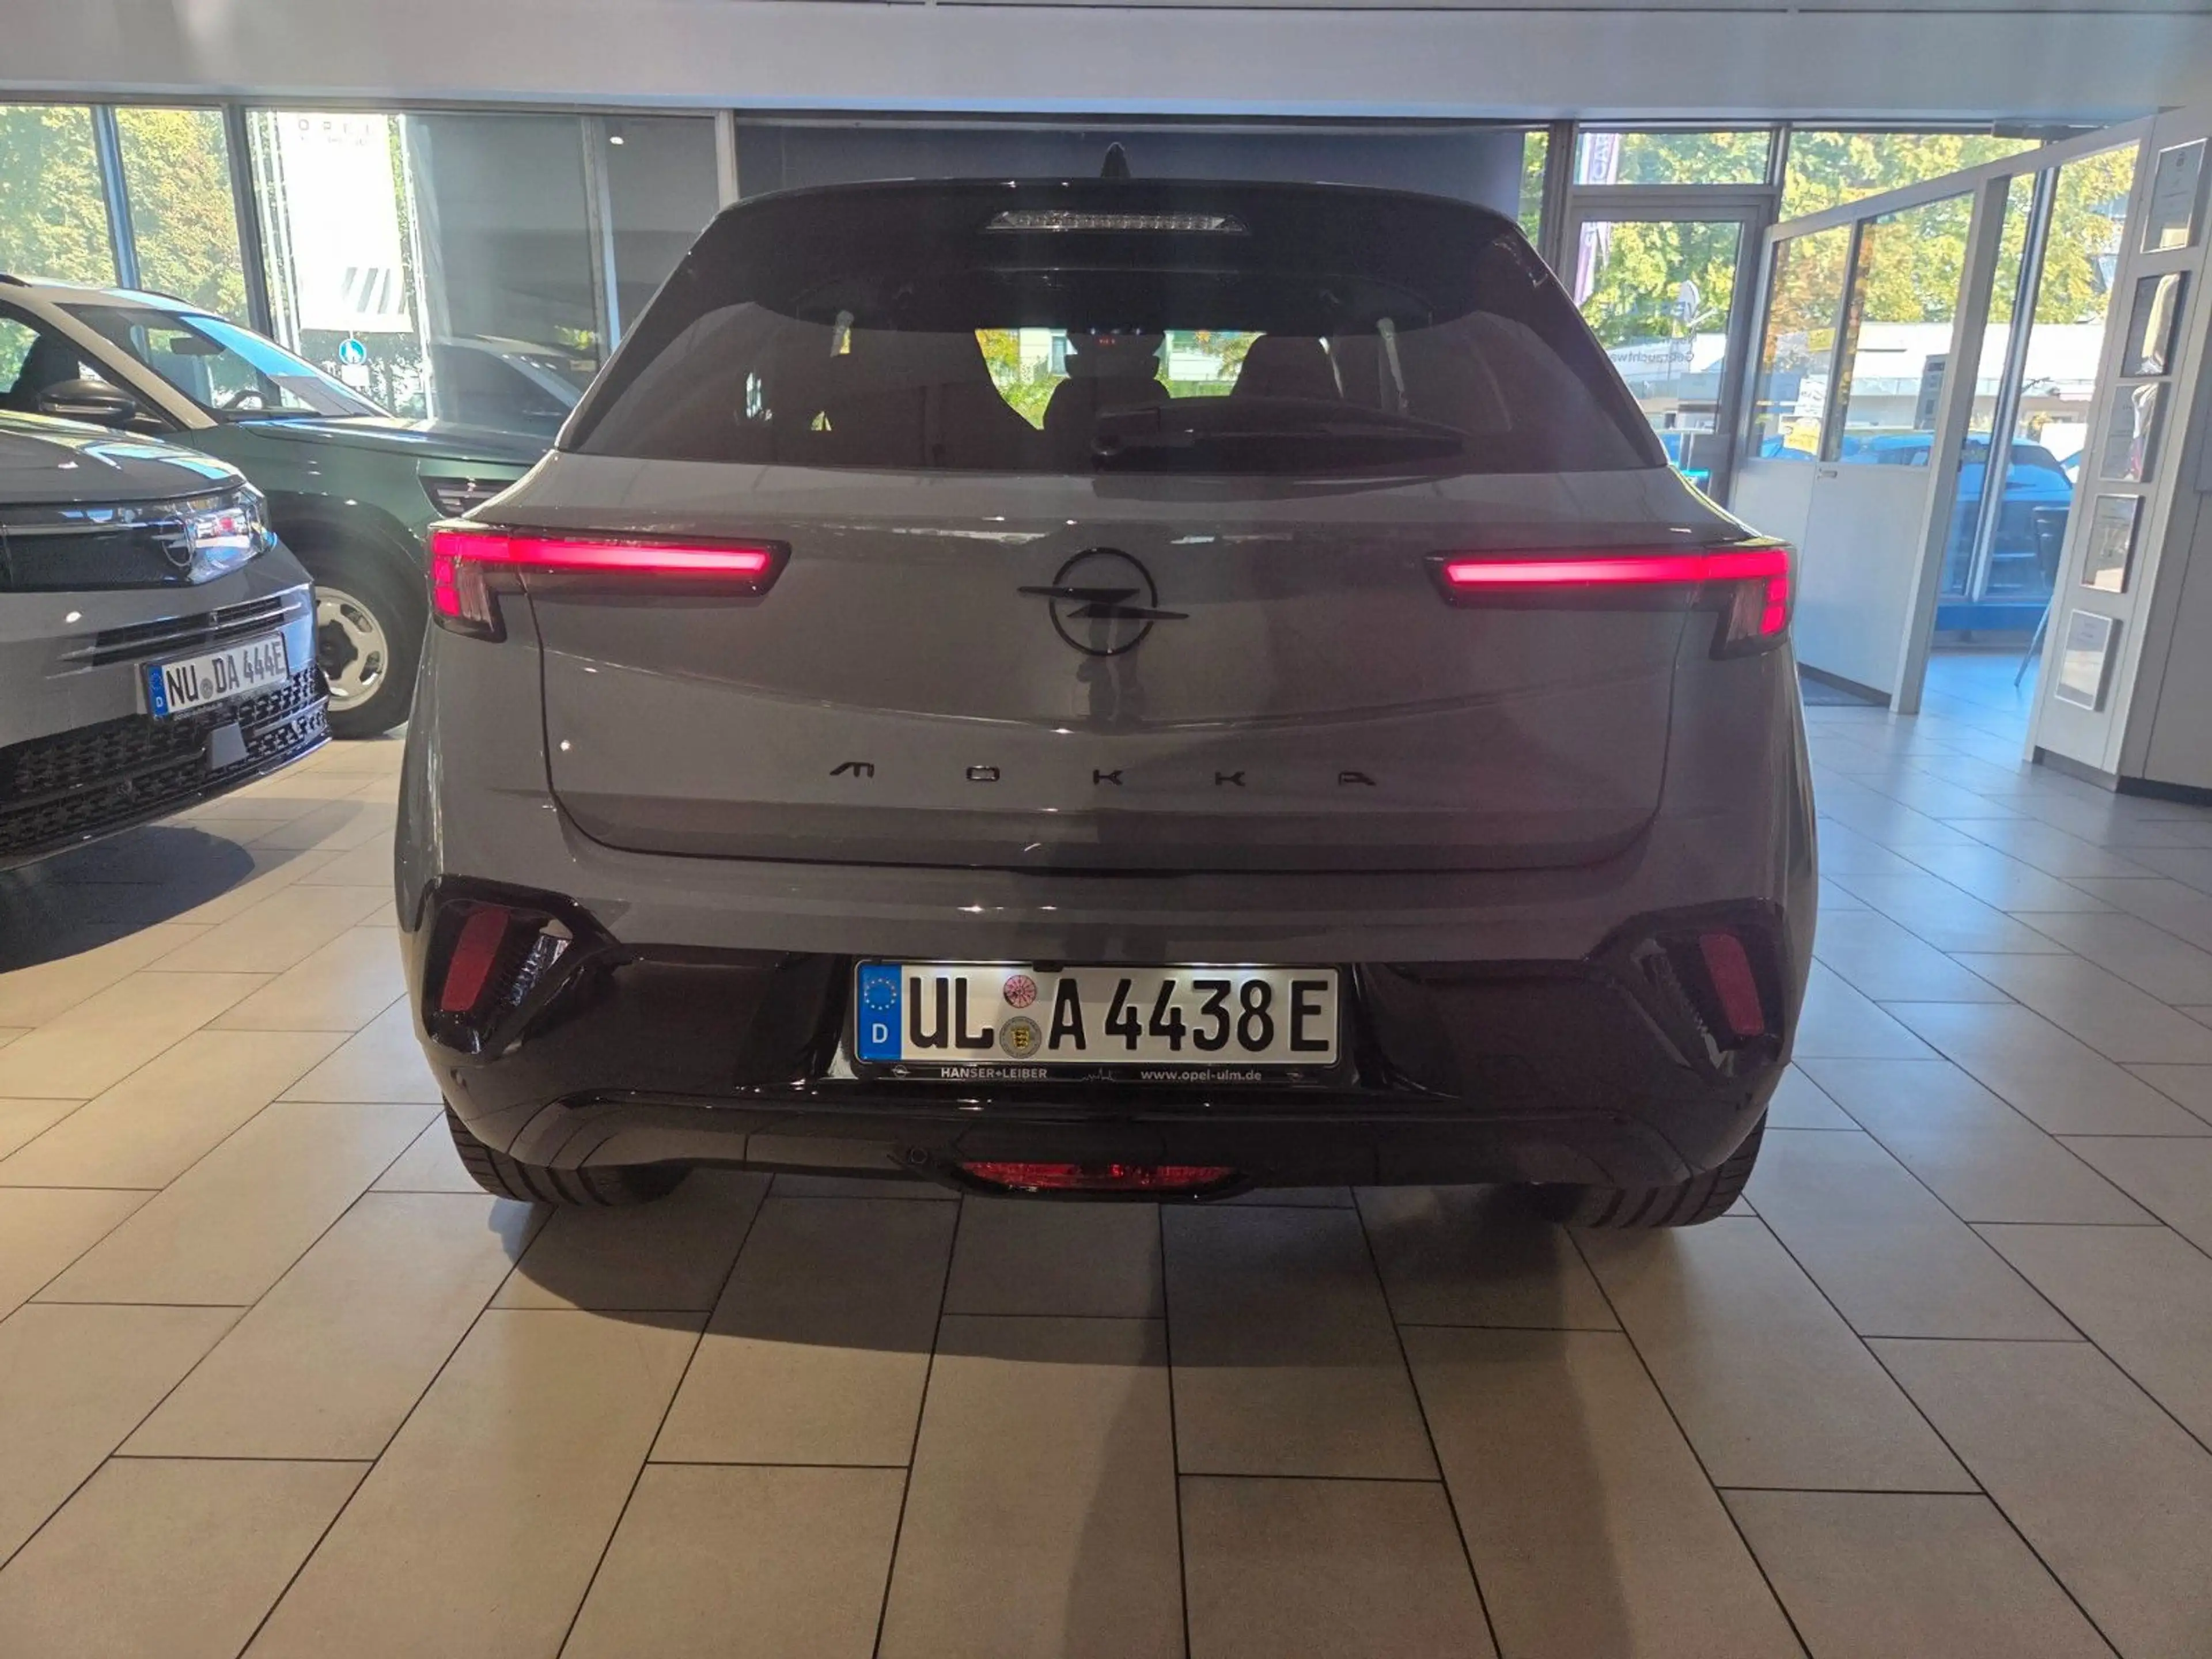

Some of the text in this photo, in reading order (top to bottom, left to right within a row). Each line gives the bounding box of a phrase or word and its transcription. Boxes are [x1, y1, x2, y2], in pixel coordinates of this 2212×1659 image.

[166, 664, 199, 706] NU
[212, 654, 240, 694] DA
[156, 697, 164, 707] D
[909, 976, 994, 1050] UL
[1049, 979, 1086, 1050] A
[872, 1023, 888, 1043] D
[1141, 1070, 1262, 1081] www.opel-ulm.de
